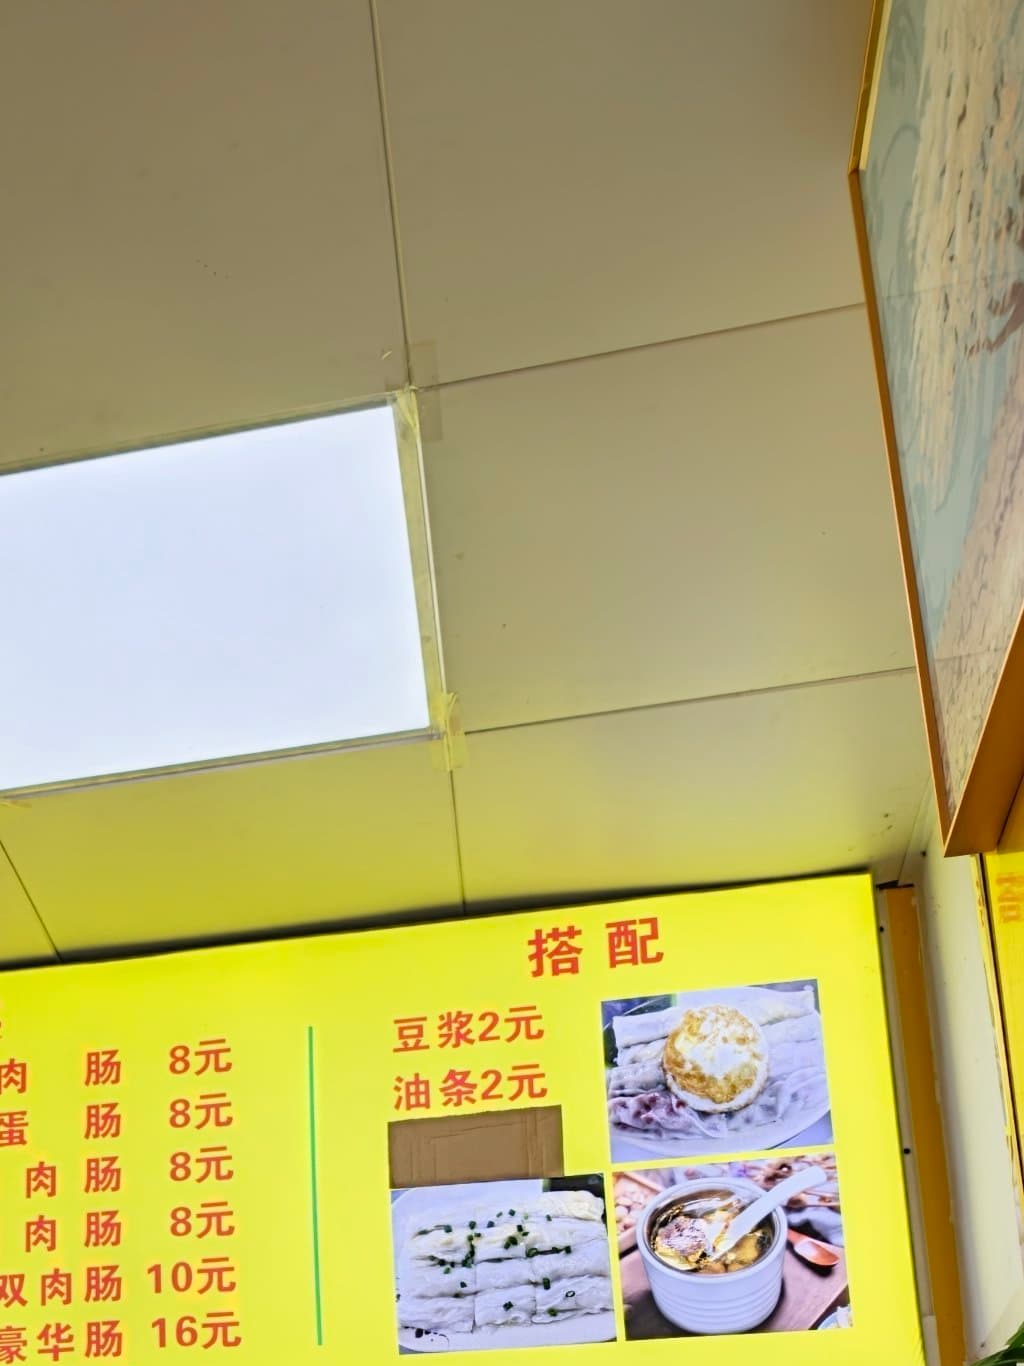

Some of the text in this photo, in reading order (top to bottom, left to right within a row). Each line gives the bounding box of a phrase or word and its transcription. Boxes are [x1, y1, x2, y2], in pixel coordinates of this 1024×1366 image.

[527, 916, 664, 979] 搭配
[392, 1004, 546, 1054] 豆浆2元
[168, 1038, 233, 1076] 8元
[392, 1062, 549, 1111] 油条2元
[168, 1092, 234, 1130] 8元
[168, 1146, 235, 1184] 8元
[169, 1200, 236, 1239] 8元
[146, 1256, 237, 1295] 10元
[151, 1311, 242, 1349] 16元
